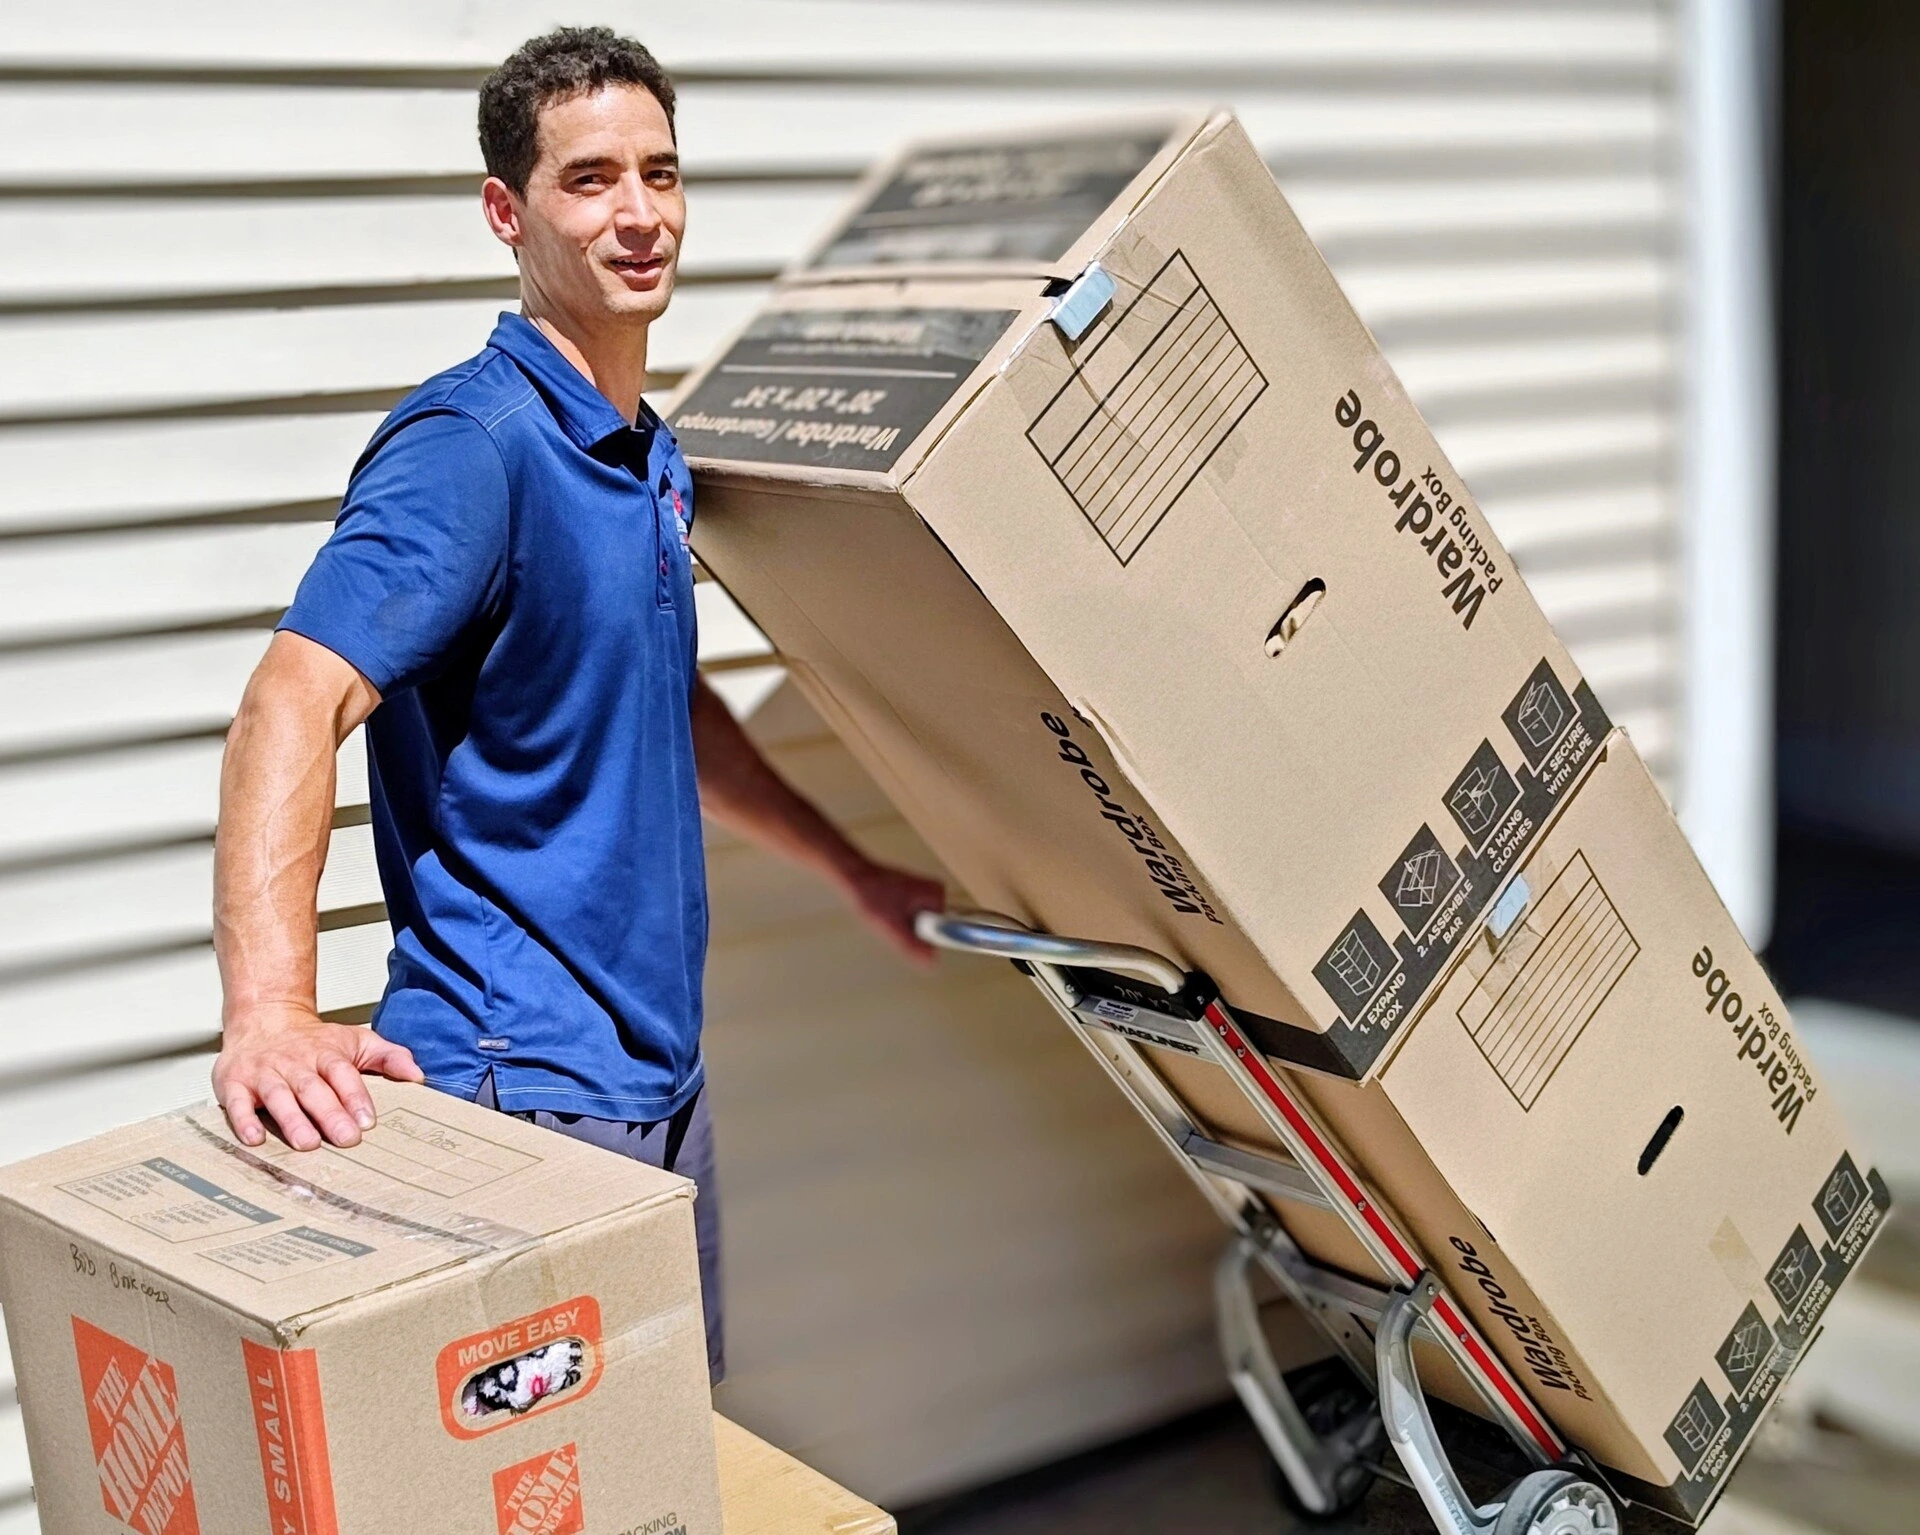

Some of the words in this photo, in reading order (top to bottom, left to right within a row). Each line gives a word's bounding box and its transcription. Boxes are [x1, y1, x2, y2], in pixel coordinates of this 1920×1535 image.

[785, 421, 901, 451] Wardrobe
[1335, 388, 1486, 631] Wardrobe
[1421, 465, 1453, 515] Box
[1449, 506, 1503, 595] Packing
[1546, 763, 1572, 795] WITH
[1569, 733, 1593, 764] TAPE
[1549, 721, 1585, 772] SECURE
[1040, 711, 1202, 915] Wardrobe
[1132, 812, 1167, 851] Box
[1495, 809, 1523, 847] HANG
[1492, 817, 1533, 873] CLOTHES
[1162, 853, 1224, 925] Packing
[1428, 879, 1474, 946] ASSEMBLE
[1442, 916, 1463, 944] BAR
[1367, 972, 1406, 1025] EXPAND
[1380, 999, 1403, 1030] BOX
[1758, 1002, 1781, 1041] Box
[1692, 945, 1805, 1135] Wardrobe
[1778, 1031, 1817, 1102] Packing
[1845, 1199, 1875, 1244] SECURE
[1842, 1235, 1863, 1264] WITH
[1449, 1236, 1571, 1391] Wardrobe
[1799, 1285, 1832, 1335] CLOTHES
[1802, 1279, 1824, 1313] HANG
[457, 1328, 521, 1367] MOVE
[527, 1307, 580, 1342] EASY
[1524, 1314, 1553, 1344] Box
[93, 1355, 129, 1428] THE
[1547, 1345, 1593, 1402] Packing
[1759, 1374, 1776, 1400] BAR
[98, 1358, 180, 1523] HOME
[256, 1368, 292, 1504] SMALL
[1701, 1427, 1732, 1474] EXPAND
[140, 1440, 191, 1535] DEPOT
[1710, 1450, 1728, 1477] BOX
[503, 1470, 538, 1512] THE
